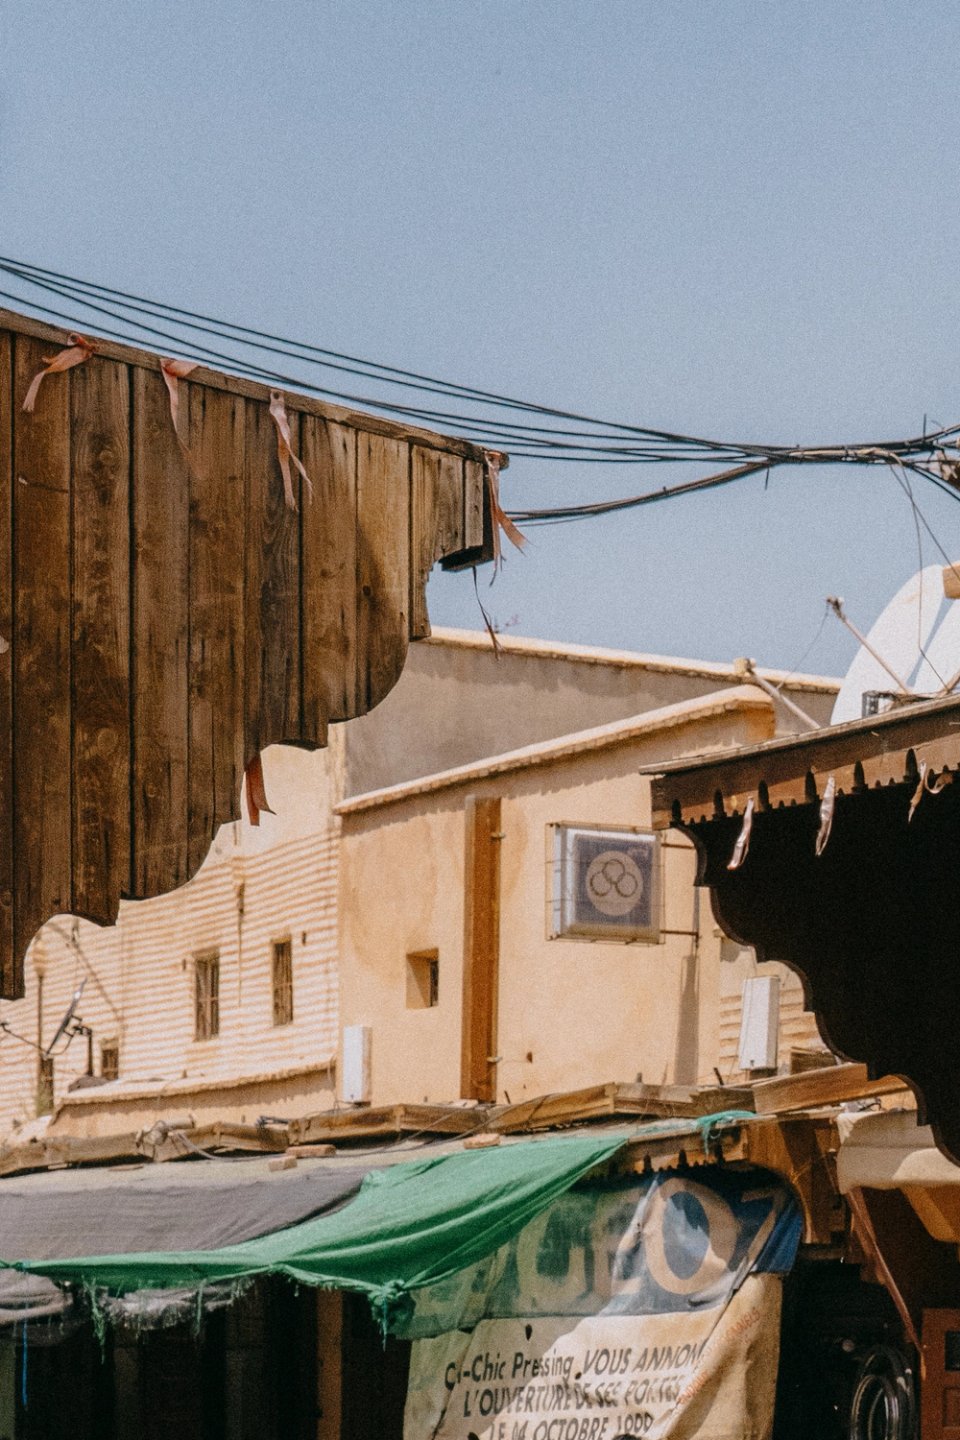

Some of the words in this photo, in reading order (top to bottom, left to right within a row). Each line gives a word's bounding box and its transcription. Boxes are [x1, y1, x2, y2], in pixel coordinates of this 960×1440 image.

[511, 1347, 575, 1388] Pressing
[583, 1347, 632, 1376] VOUS
[463, 1384, 571, 1418] L'OUVERTURE
